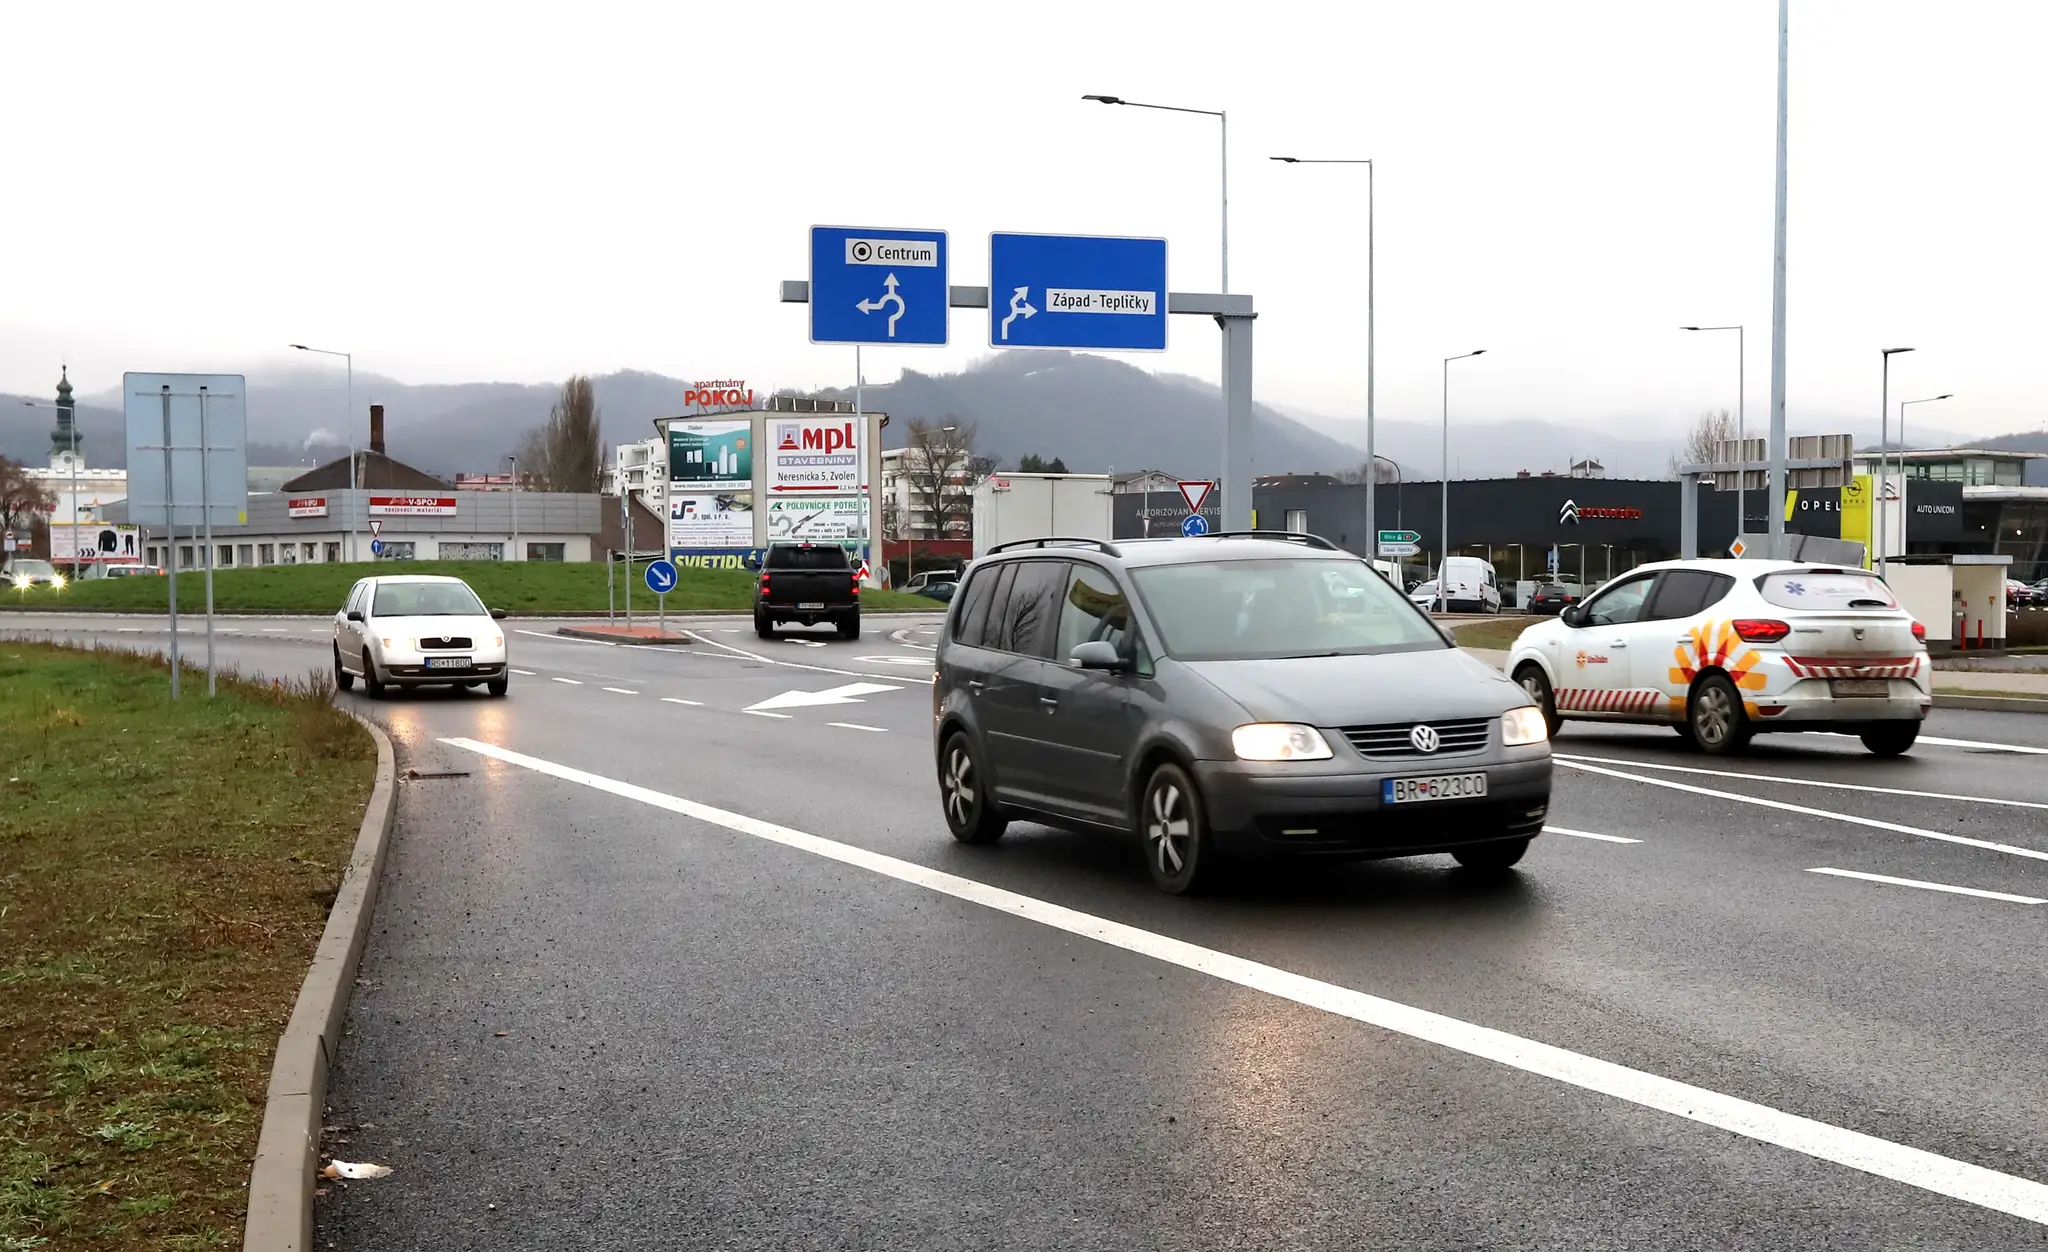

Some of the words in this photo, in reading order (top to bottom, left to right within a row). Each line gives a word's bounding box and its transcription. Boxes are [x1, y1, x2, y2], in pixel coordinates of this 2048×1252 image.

[877, 244, 931, 262] Centrum
[1053, 292, 1090, 310] Západ
[1100, 295, 1149, 312] Tepličky
[694, 379, 745, 390] apartmány
[685, 389, 753, 406] POKOJ
[779, 456, 853, 465] STAVEBNINY
[831, 470, 856, 481] Zvolen
[834, 501, 868, 510] POTREY
[1801, 500, 1842, 511] OPEL
[1916, 504, 1933, 513] AUTO
[1933, 505, 1955, 514] UNICOM
[1135, 506, 1195, 517] AUTORIZOVAN
[1196, 506, 1221, 516] ERVIS
[1395, 780, 1418, 801] BR
